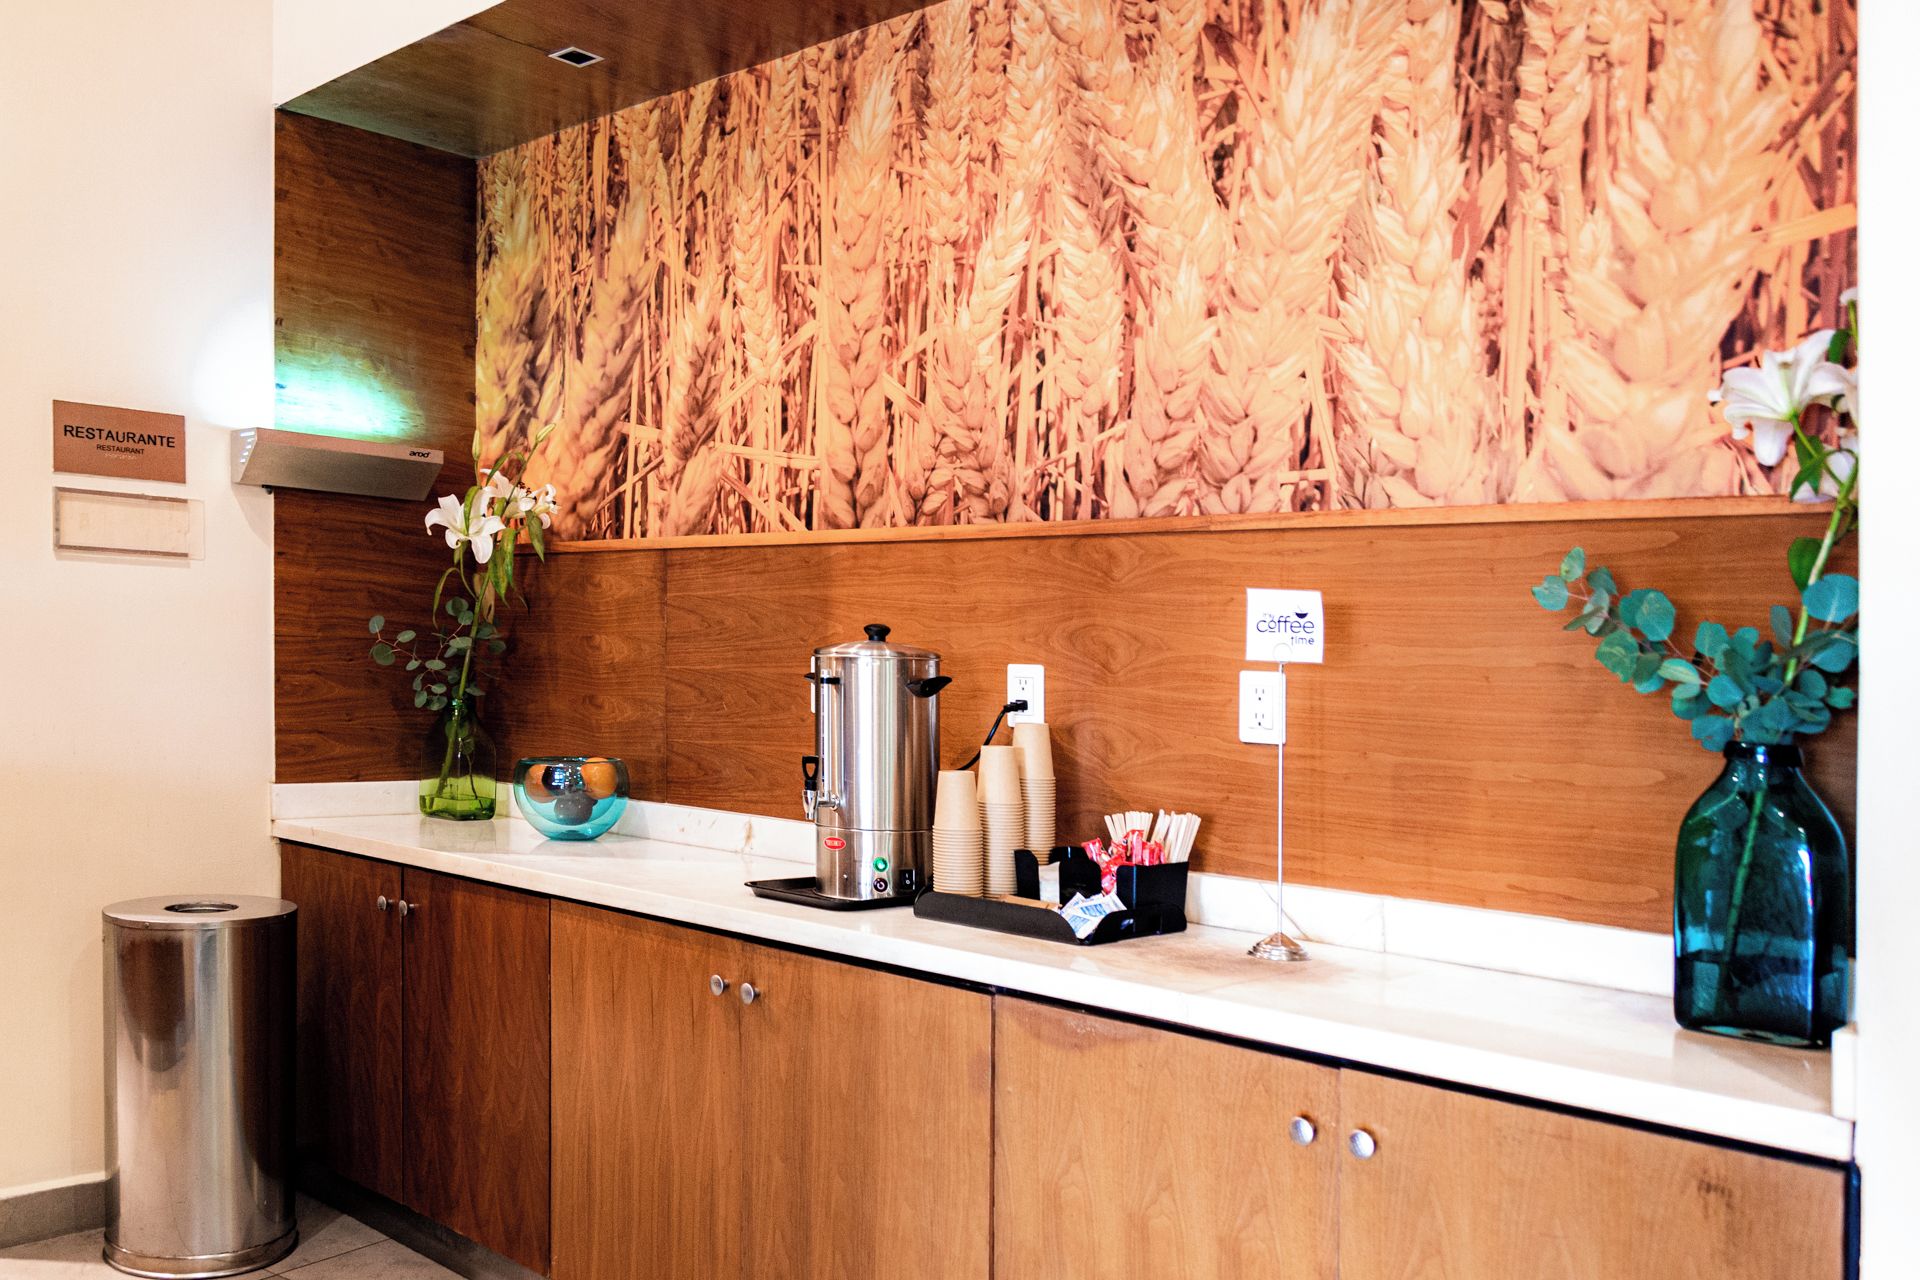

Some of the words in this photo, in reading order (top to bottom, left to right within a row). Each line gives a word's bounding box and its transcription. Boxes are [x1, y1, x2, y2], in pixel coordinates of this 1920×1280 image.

[63, 424, 175, 448] RESTAURANTE
[96, 443, 144, 455] RESTAURANT
[1256, 615, 1314, 634] coffee
[1290, 636, 1315, 646] time
